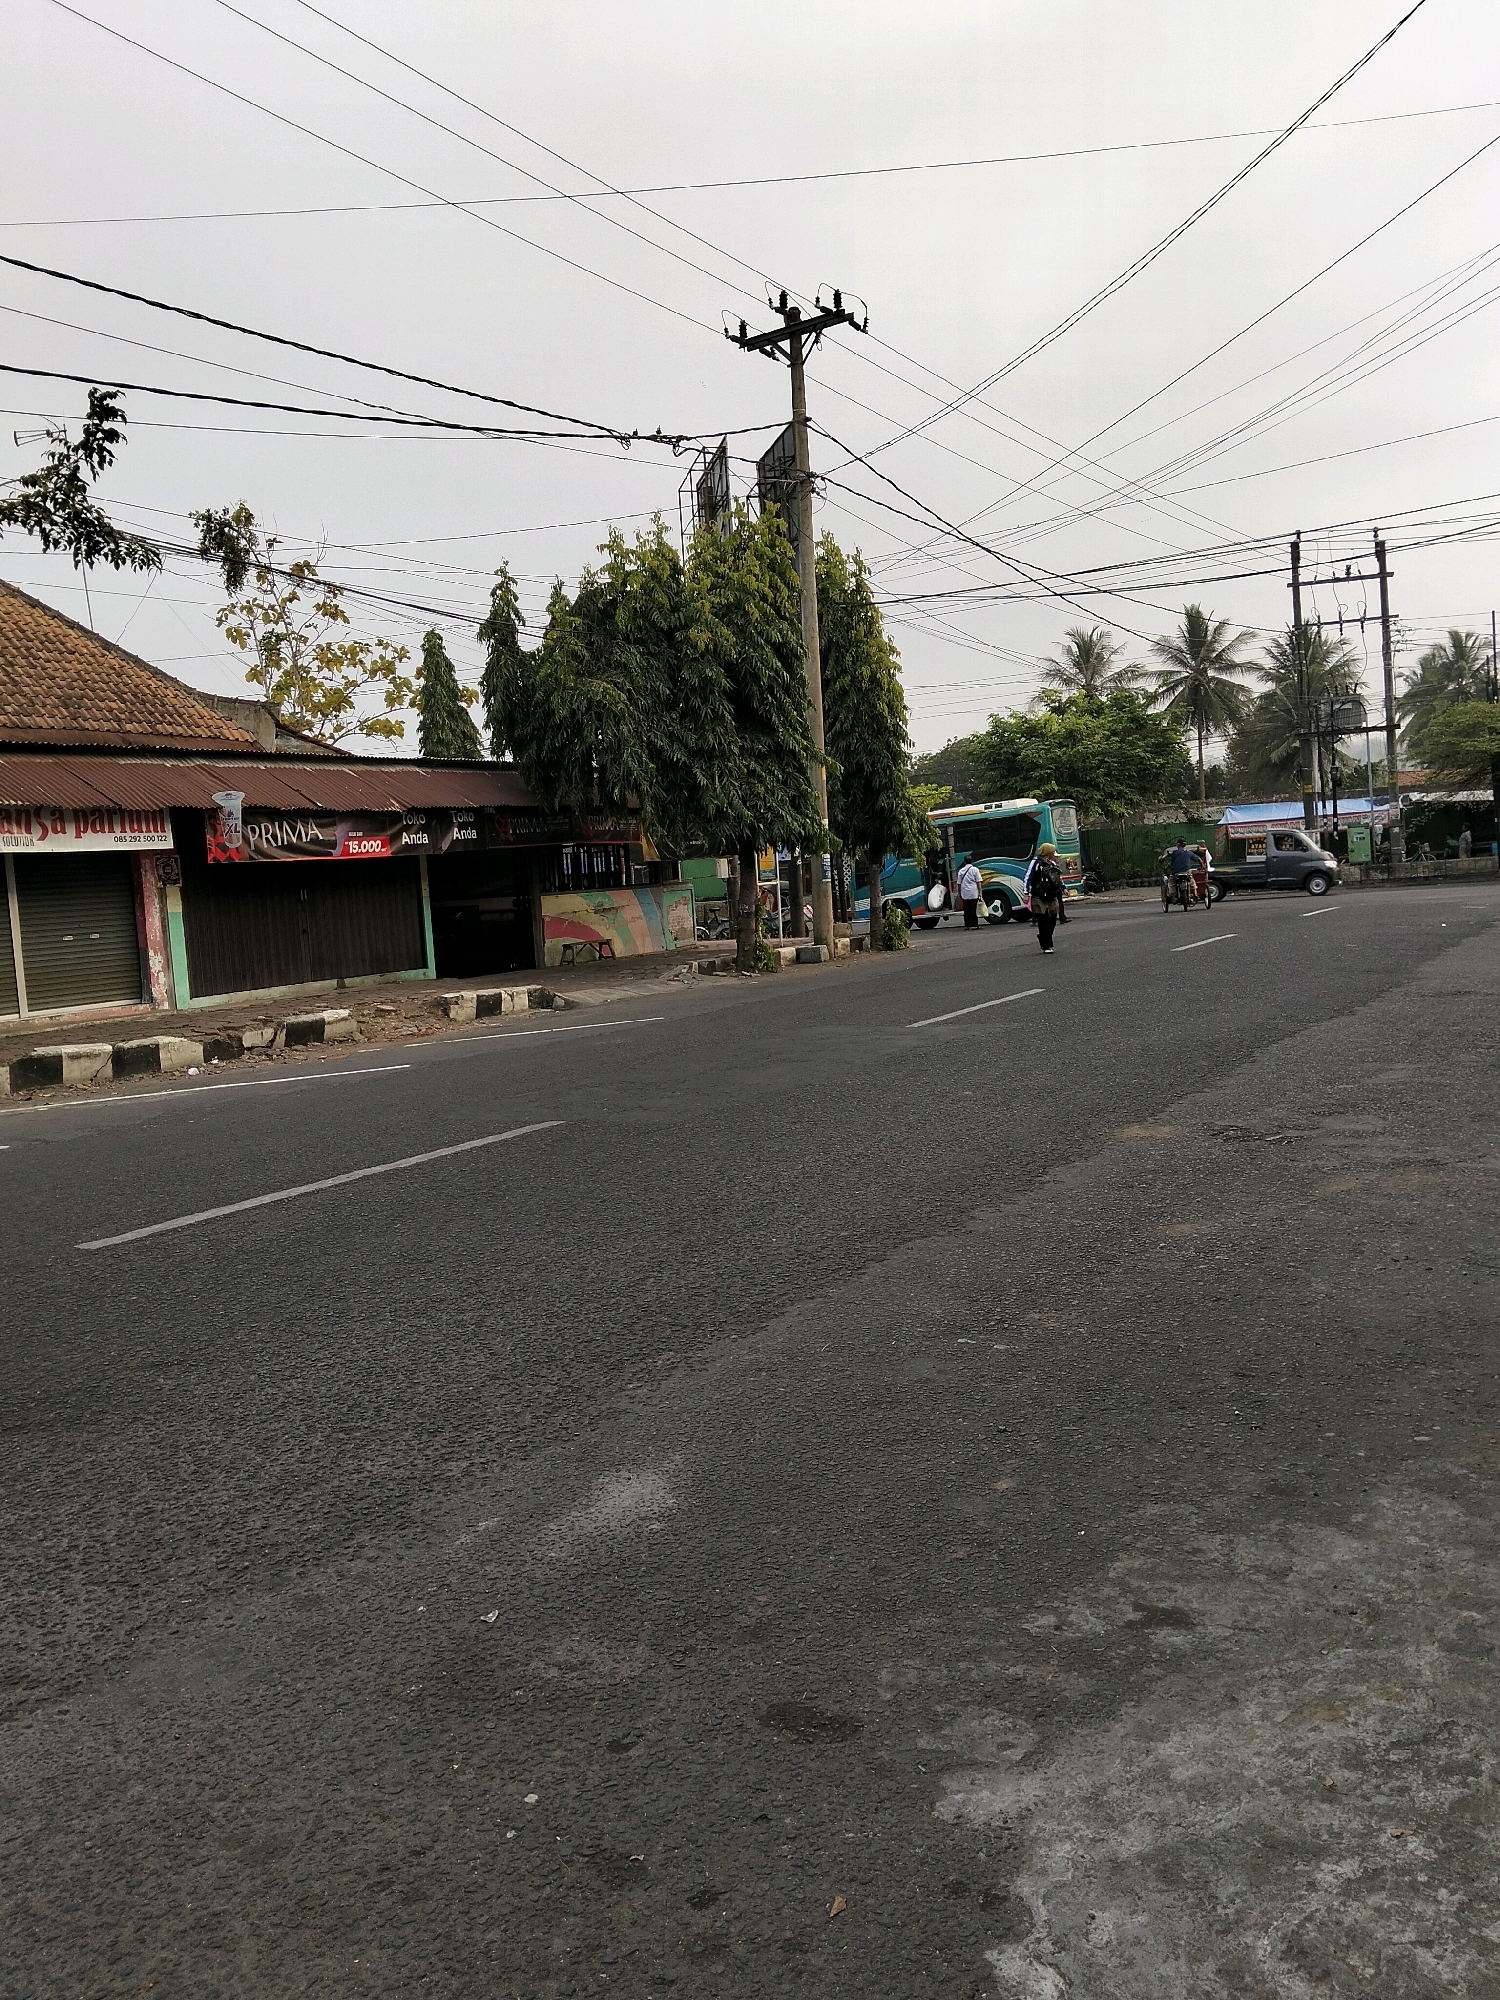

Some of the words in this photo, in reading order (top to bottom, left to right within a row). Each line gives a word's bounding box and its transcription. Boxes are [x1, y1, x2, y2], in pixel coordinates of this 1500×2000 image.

[402, 811, 426, 825] Toko
[450, 810, 475, 823] Toko
[225, 822, 241, 837] XL
[508, 816, 549, 834] PRIMA
[113, 835, 128, 843] 085
[129, 835, 142, 843] 292
[247, 817, 324, 851] PRIMA
[402, 831, 429, 845] Anda
[453, 827, 478, 840] Anda
